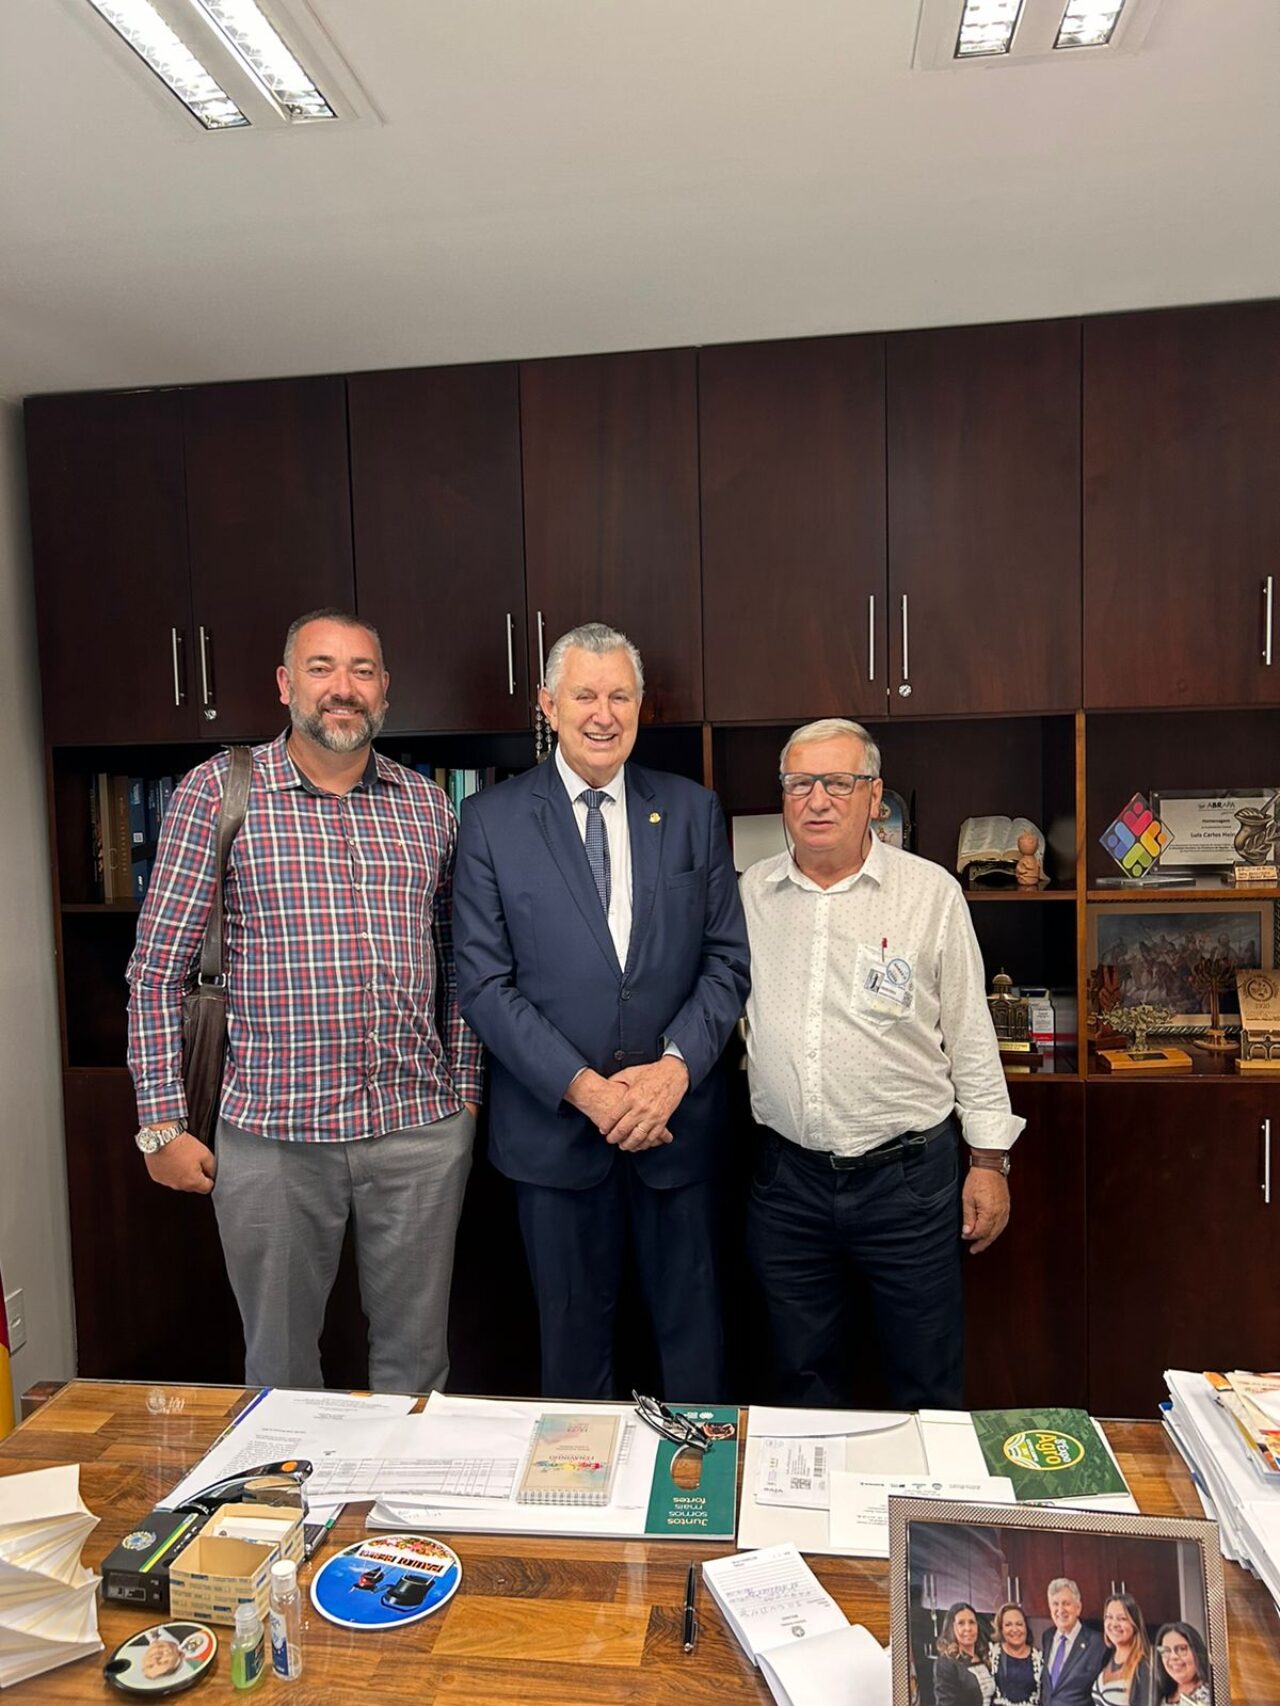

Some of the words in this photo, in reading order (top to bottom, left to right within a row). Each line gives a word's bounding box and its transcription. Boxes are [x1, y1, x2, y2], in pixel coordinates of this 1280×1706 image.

[1207, 801, 1235, 809] ABRAPA
[1035, 1433, 1062, 1465] Agro
[668, 1510, 708, 1518] somos
[666, 1517, 709, 1526] Juntos
